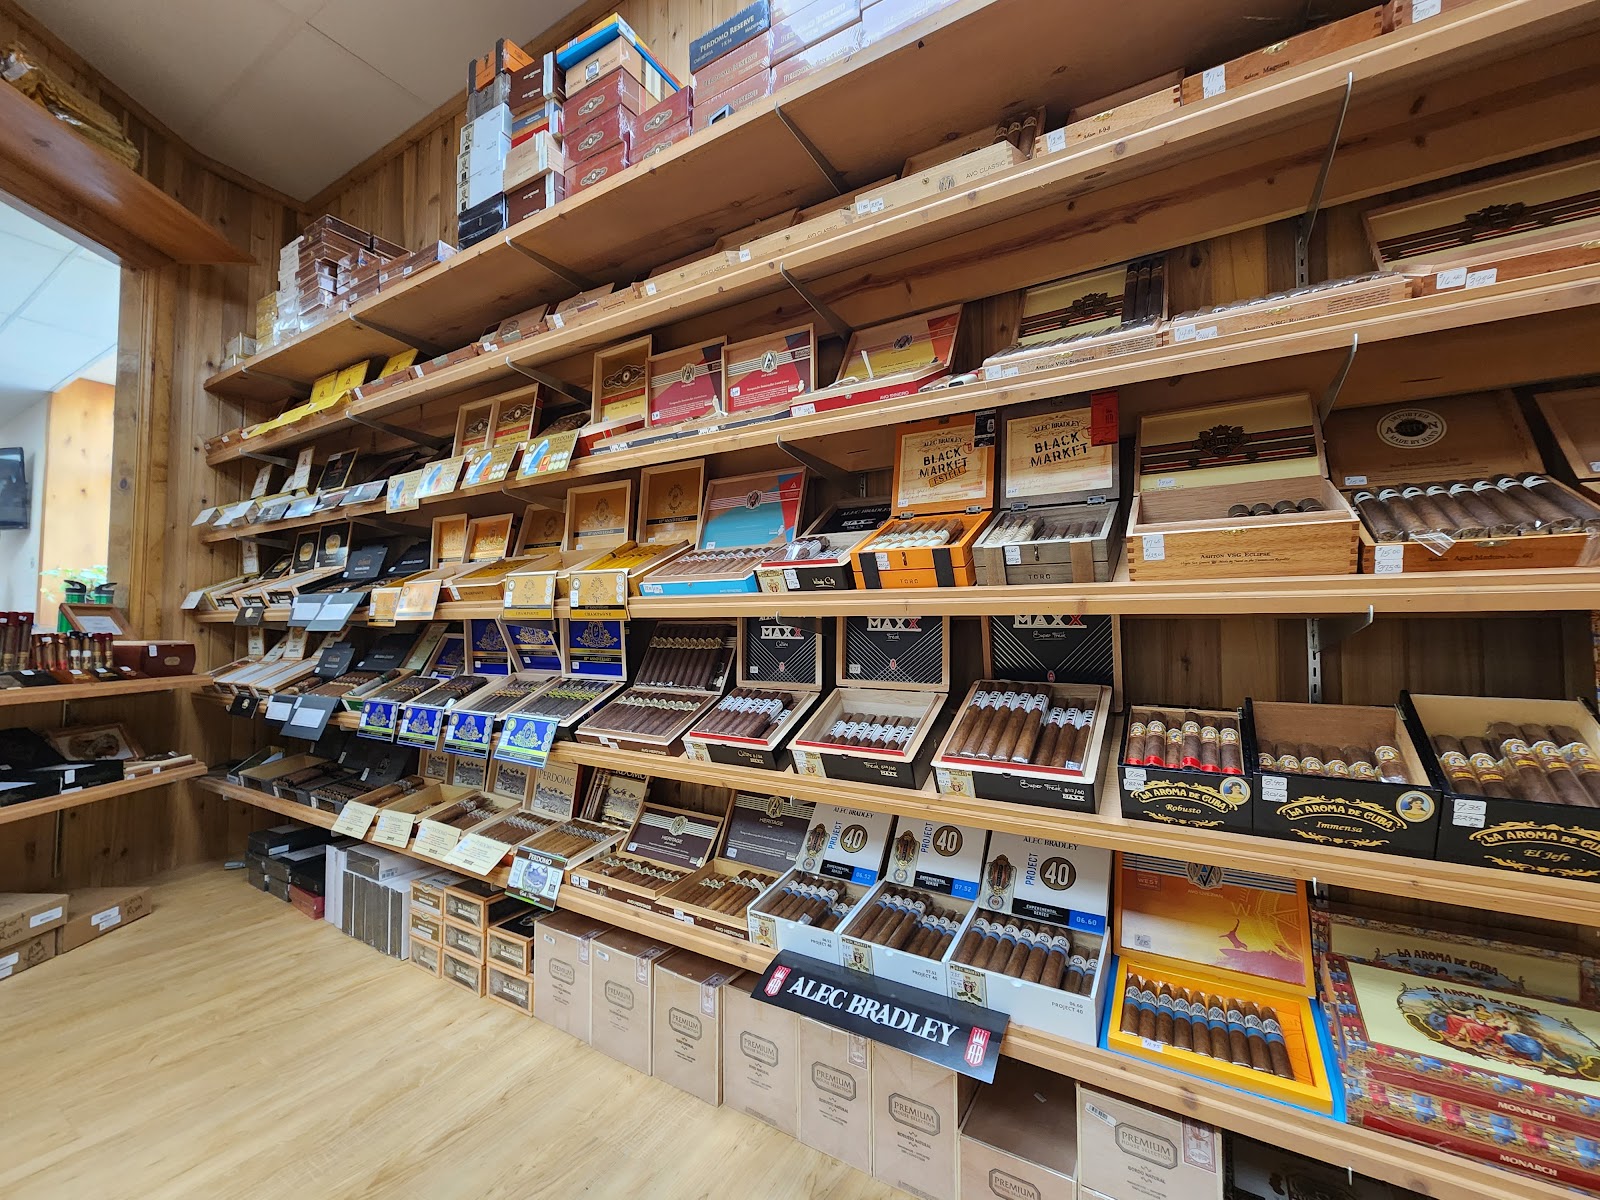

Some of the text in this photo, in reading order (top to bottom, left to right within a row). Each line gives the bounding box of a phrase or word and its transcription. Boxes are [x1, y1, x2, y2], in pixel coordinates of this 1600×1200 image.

[700, 14, 755, 53] PERDOMO RESERVE
[1262, 60, 1290, 75] Magnum
[965, 160, 1006, 179] AVO CLASSIC
[1055, 359, 1068, 367] VSG
[1389, 411, 1430, 423] IMPORTED
[1033, 420, 1081, 433] ALEC BRADLEY
[1034, 431, 1080, 454] BLACK
[1204, 437, 1239, 447] ASHTON
[1391, 434, 1410, 445] MADE
[1421, 430, 1439, 444] HAND
[923, 447, 961, 466] BLACK
[1030, 442, 1088, 467] MARKET
[919, 456, 968, 478] MARKET
[867, 617, 922, 631] MAXX
[1013, 614, 1083, 627] MAXX
[761, 626, 804, 639] MAXX
[1019, 779, 1043, 791] Super
[1062, 793, 1085, 802] MAXX
[1140, 788, 1228, 811] LA AROMA DE CUBA
[848, 810, 875, 819] BRADLEY
[1165, 803, 1202, 814] Robusto
[759, 817, 784, 827] HERITAGE
[1287, 804, 1394, 830] LA AROMA DE CUBA
[1316, 821, 1364, 834] Immensa
[827, 821, 843, 850] PROJECT
[843, 828, 864, 849] 40
[920, 822, 934, 854] PROJECT
[936, 829, 958, 852] 40
[1483, 830, 1580, 845] LA AROMA DE
[1023, 836, 1079, 851] ALEC BRADLEY
[528, 852, 552, 865] PERDOMO
[1523, 849, 1571, 862] El Jefe
[855, 871, 872, 880] 06.52
[1025, 852, 1039, 886] PROJECT
[1044, 861, 1070, 886] 40
[954, 883, 972, 893] 07.52
[1137, 877, 1159, 885] WEST
[1076, 916, 1097, 926] 06.60
[810, 939, 827, 947] PROJECT
[1397, 948, 1499, 976] LA AROMA DE CUBA
[912, 969, 932, 980] PROJECT
[607, 986, 631, 1000] PREMIUM
[1424, 985, 1541, 1015] LA AROMA DE CUBA
[787, 976, 959, 1047] ALEC BRADLEY
[1051, 1001, 1076, 1012] PROJECT
[671, 1013, 699, 1029] PREMIUM
[744, 1037, 775, 1057] PREMIUM
[816, 1068, 852, 1090] PREMIUM
[830, 1081, 852, 1094] SELECTION
[893, 1100, 935, 1123] PREMIUM
[893, 1108, 936, 1129] HOUSE SELECTION
[1497, 1101, 1556, 1122] MONARCH
[897, 1131, 915, 1142] ROBUSTO
[1121, 1130, 1171, 1156] PREMIUM
[1121, 1139, 1172, 1162] HOUSE SELECTION
[1499, 1154, 1558, 1177] MONARCH
[994, 1175, 1035, 1199] PREMIUM
